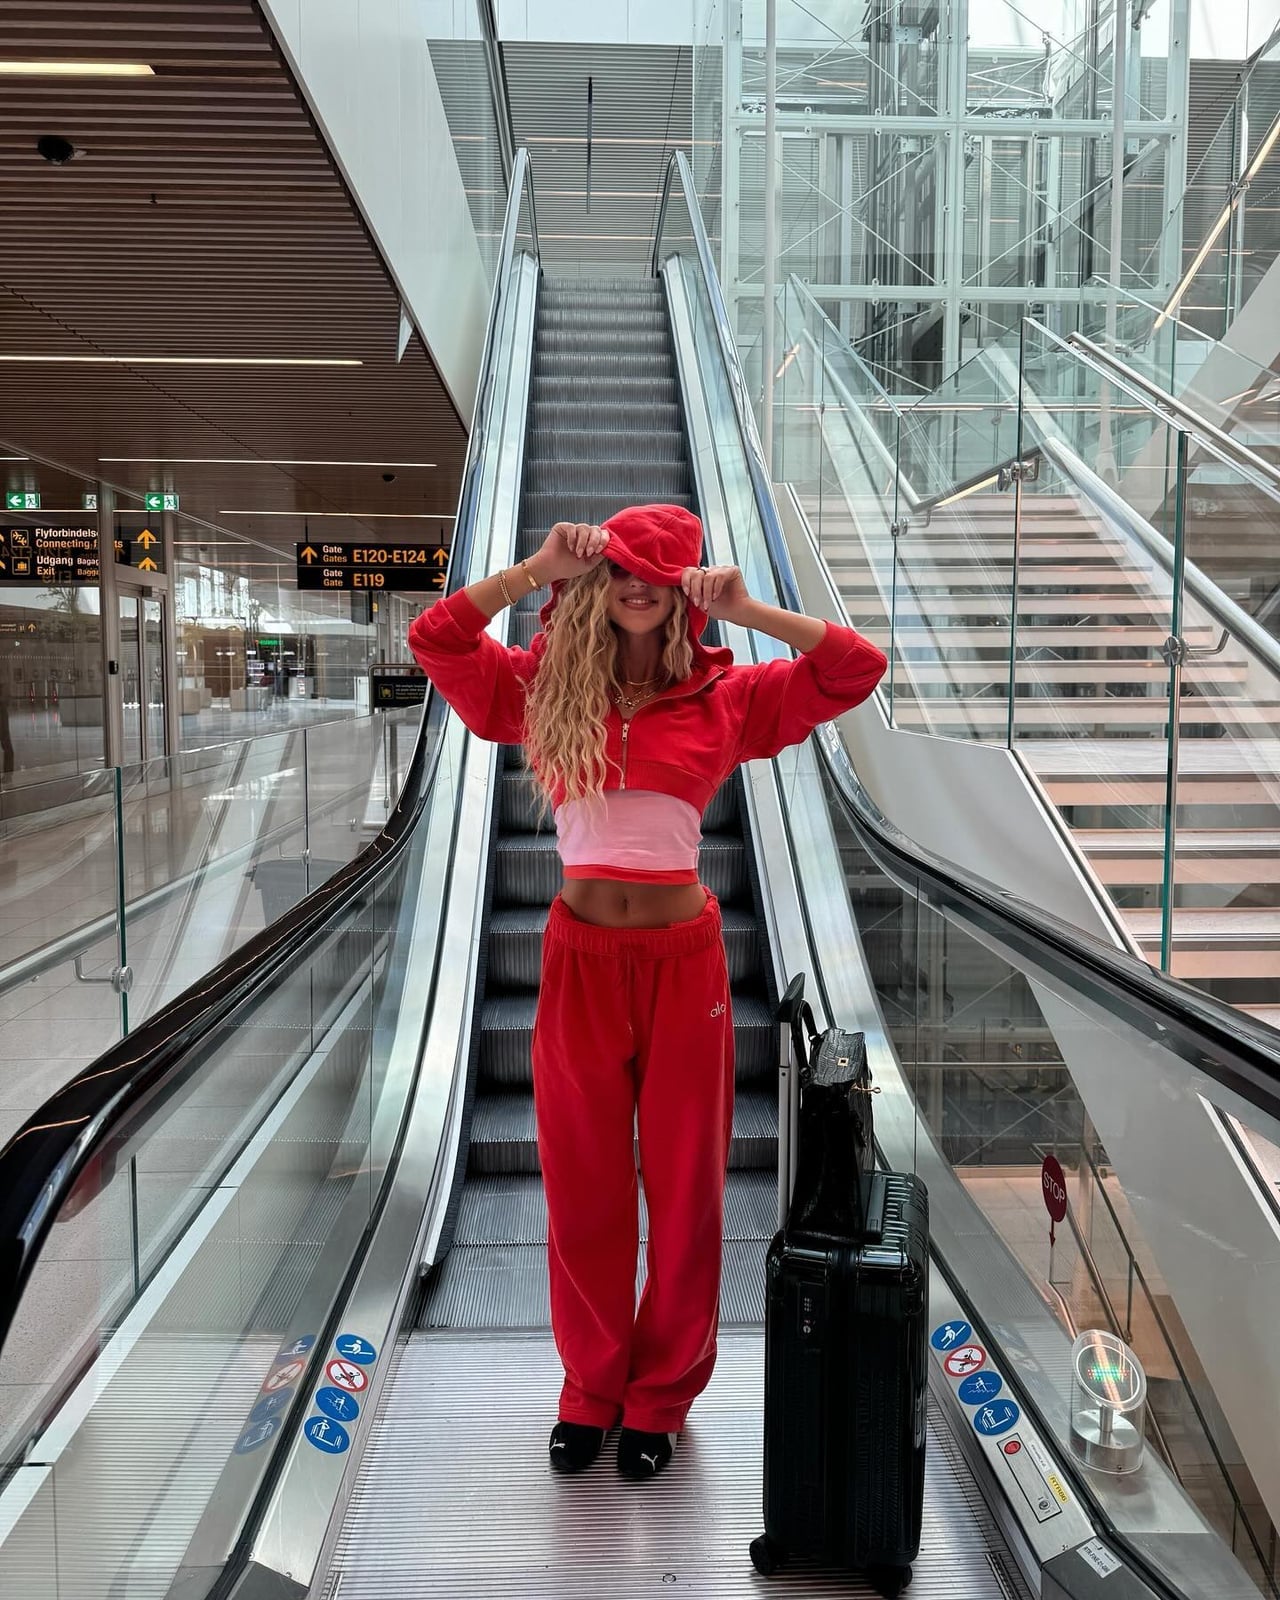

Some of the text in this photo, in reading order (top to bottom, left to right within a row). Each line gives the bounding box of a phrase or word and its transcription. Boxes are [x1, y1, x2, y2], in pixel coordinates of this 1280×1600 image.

[35, 528, 99, 539] Flyforbindels
[36, 539, 90, 550] Connecting
[322, 544, 343, 554] Gate
[36, 555, 73, 566] Udgang
[322, 554, 348, 563] Gates
[353, 549, 427, 563] E120-E124
[36, 566, 55, 576] Exit
[323, 568, 343, 578] Gate
[323, 578, 344, 587] Gate
[353, 573, 385, 587] E119
[710, 1001, 726, 1018] alo
[1043, 1171, 1066, 1203] STOP
